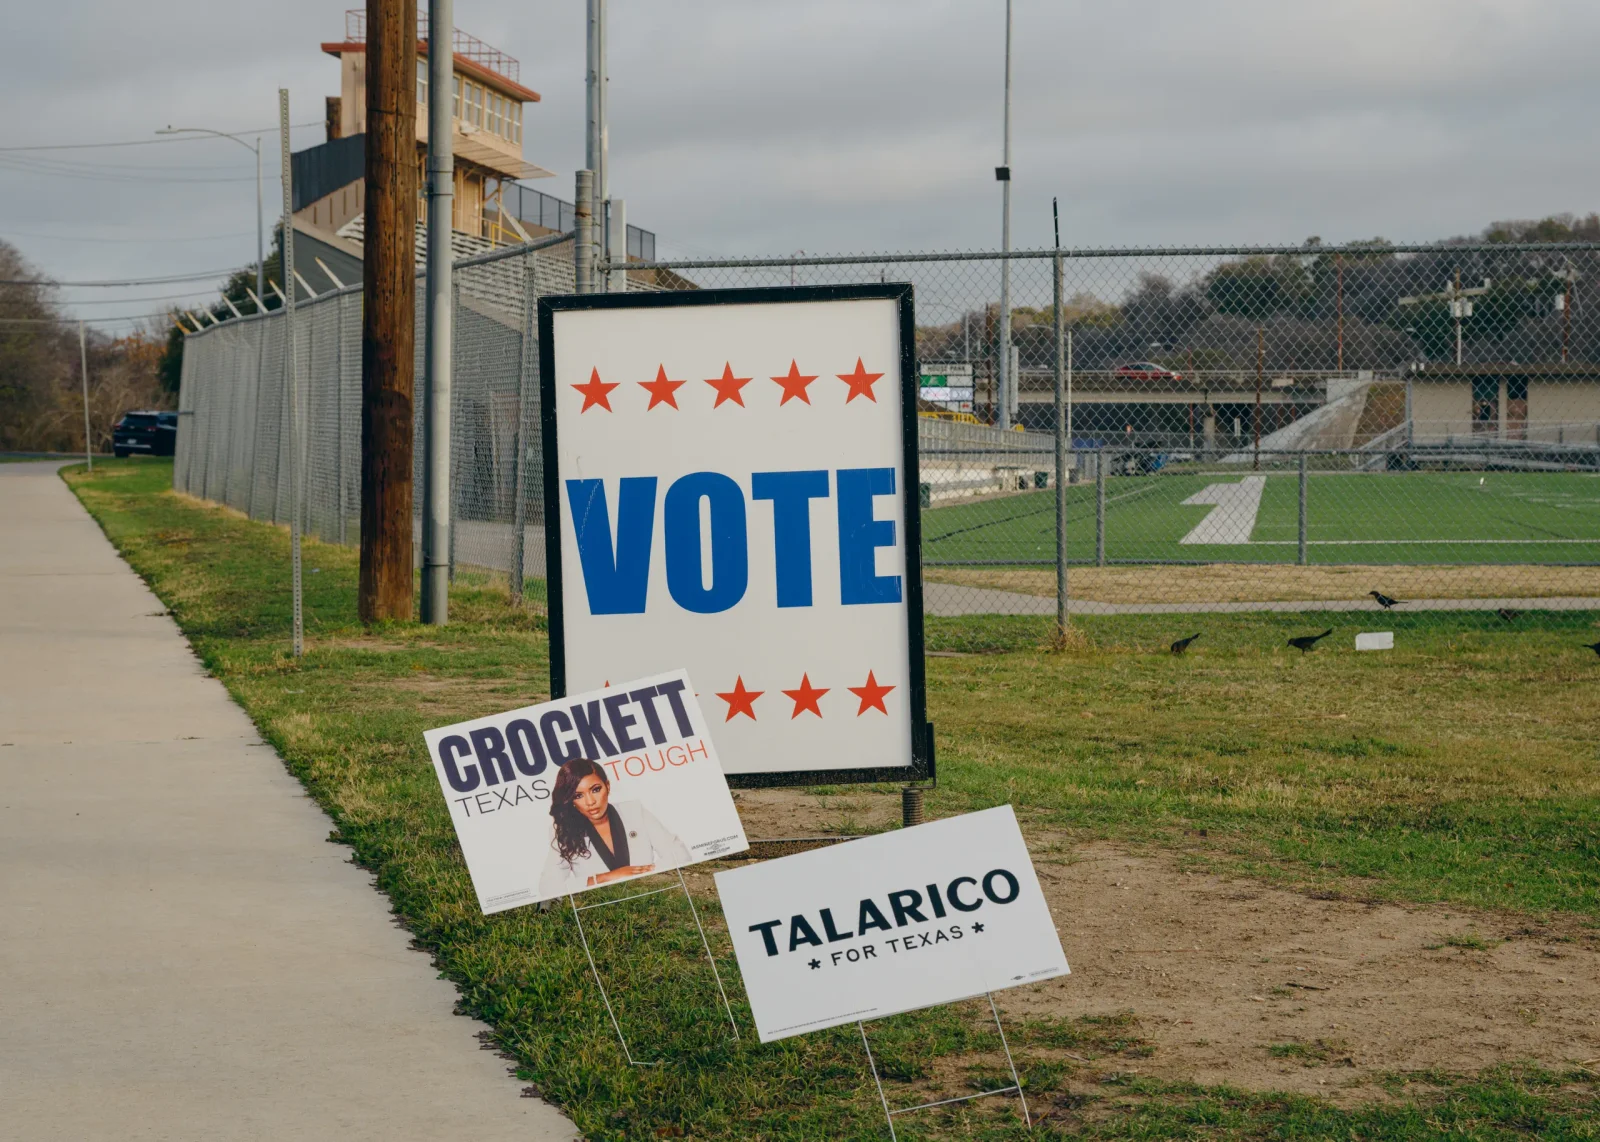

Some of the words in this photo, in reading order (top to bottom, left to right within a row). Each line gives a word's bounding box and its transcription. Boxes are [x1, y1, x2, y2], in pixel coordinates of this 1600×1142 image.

[566, 468, 902, 615] VOTE
[439, 679, 695, 793] CROCKETT
[455, 780, 551, 818] TEXAS
[604, 740, 709, 781] TOUGH
[749, 869, 1020, 957] TALARICO
[831, 945, 878, 967] FOR
[885, 926, 964, 953] TEXAS
